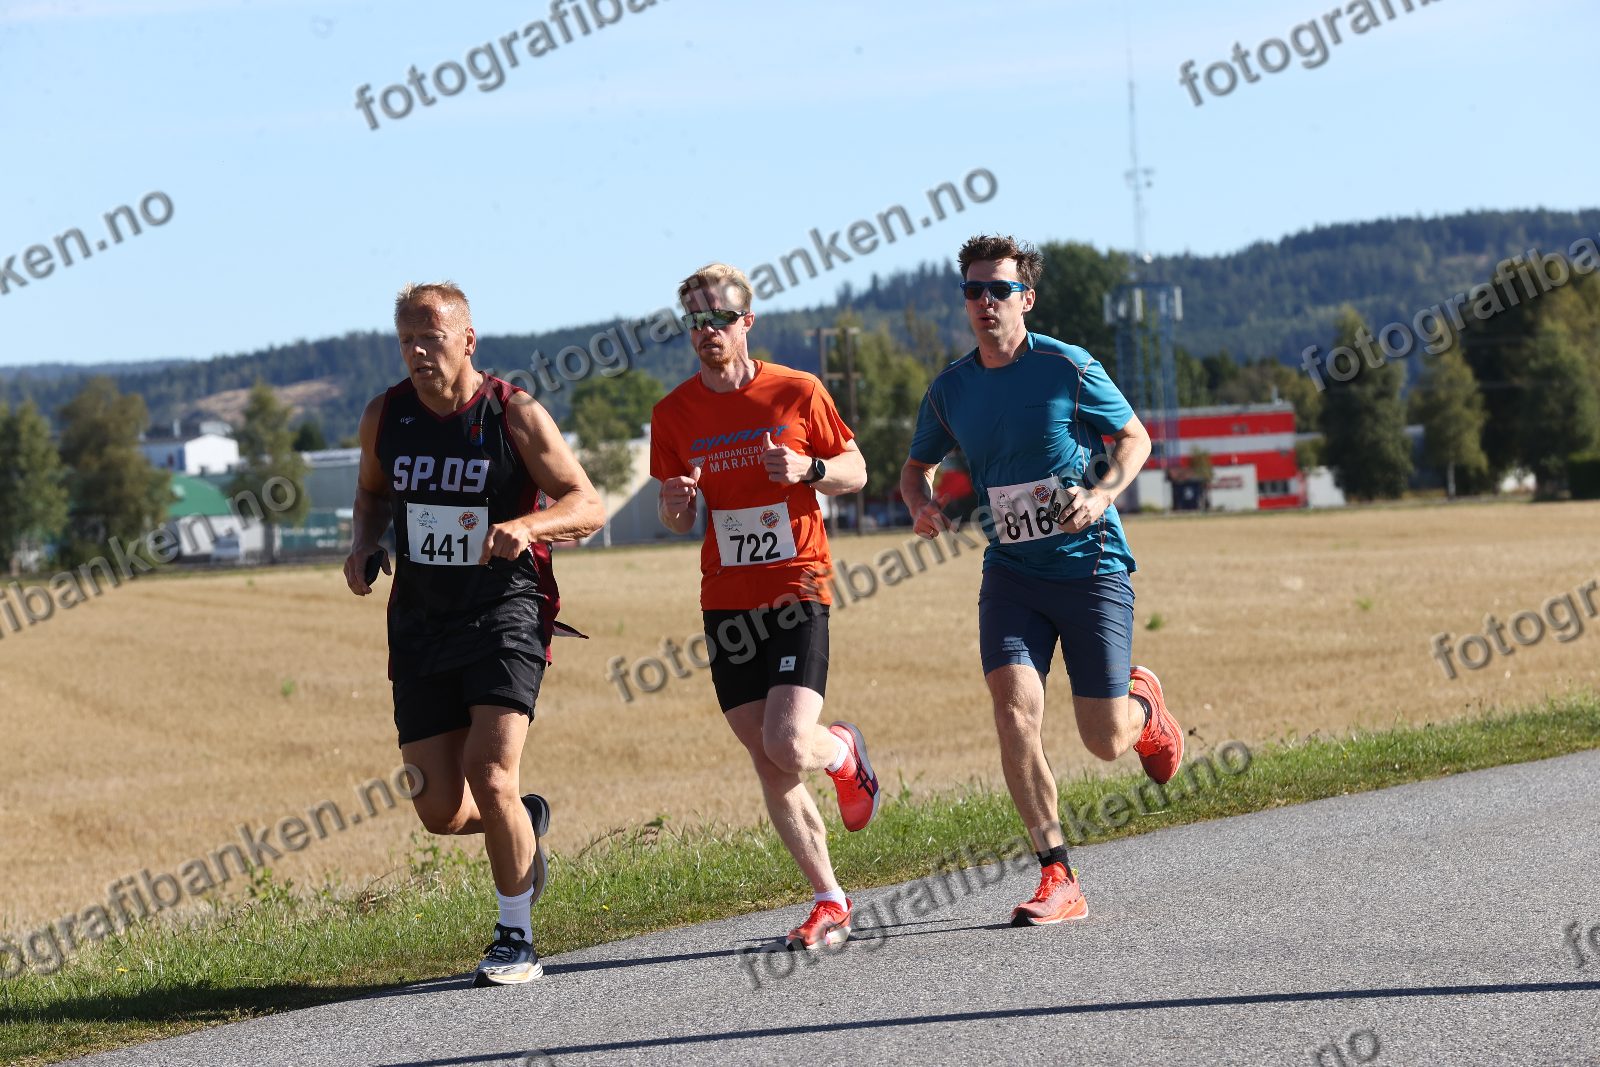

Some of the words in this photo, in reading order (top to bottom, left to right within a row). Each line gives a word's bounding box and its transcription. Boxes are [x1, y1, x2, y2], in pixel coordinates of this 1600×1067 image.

[708, 442, 787, 461] HARDANGERVA
[710, 454, 762, 472] MARAT
[394, 455, 490, 493] SP.09
[1004, 507, 1053, 540] 816
[420, 532, 469, 562] 441
[730, 531, 781, 563] 722
